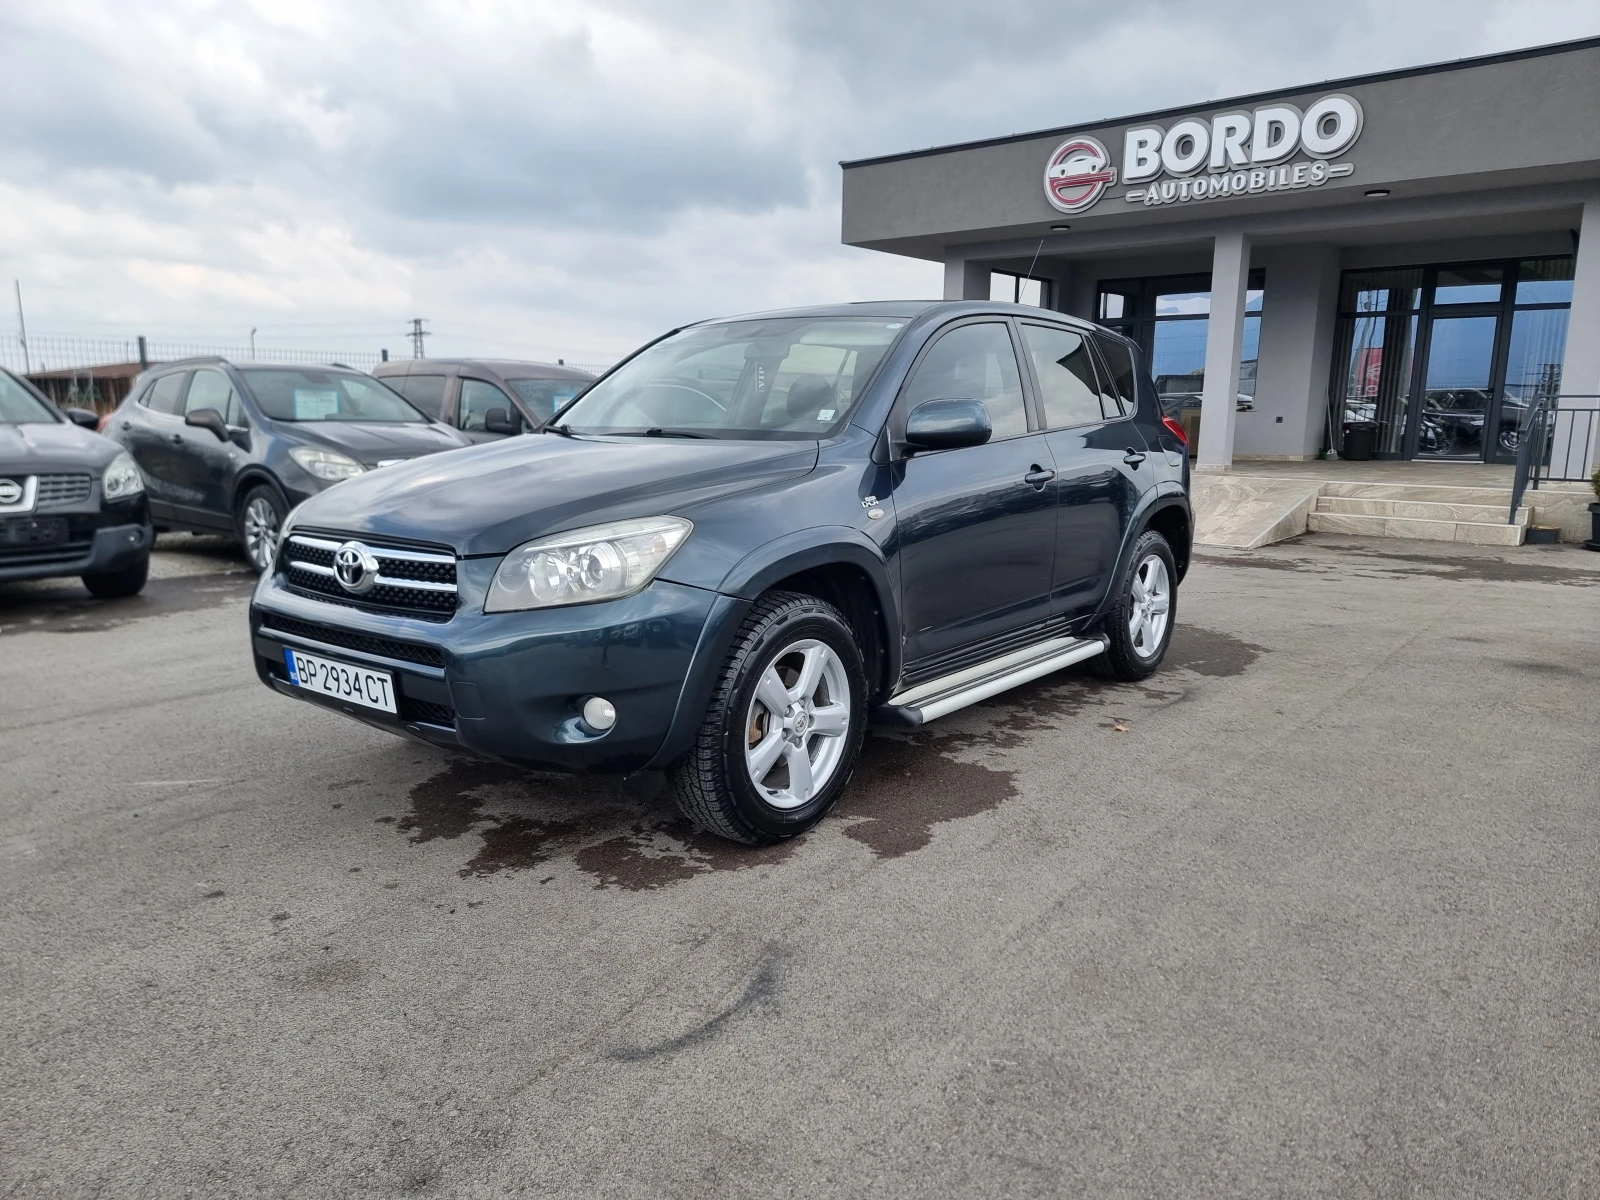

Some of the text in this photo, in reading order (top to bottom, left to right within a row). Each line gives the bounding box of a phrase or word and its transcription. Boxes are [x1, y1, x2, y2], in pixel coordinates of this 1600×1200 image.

[1123, 97, 1359, 180] BORDO
[1145, 164, 1325, 201] AUTOMOBILES
[295, 656, 388, 707] BP 2934 CT
